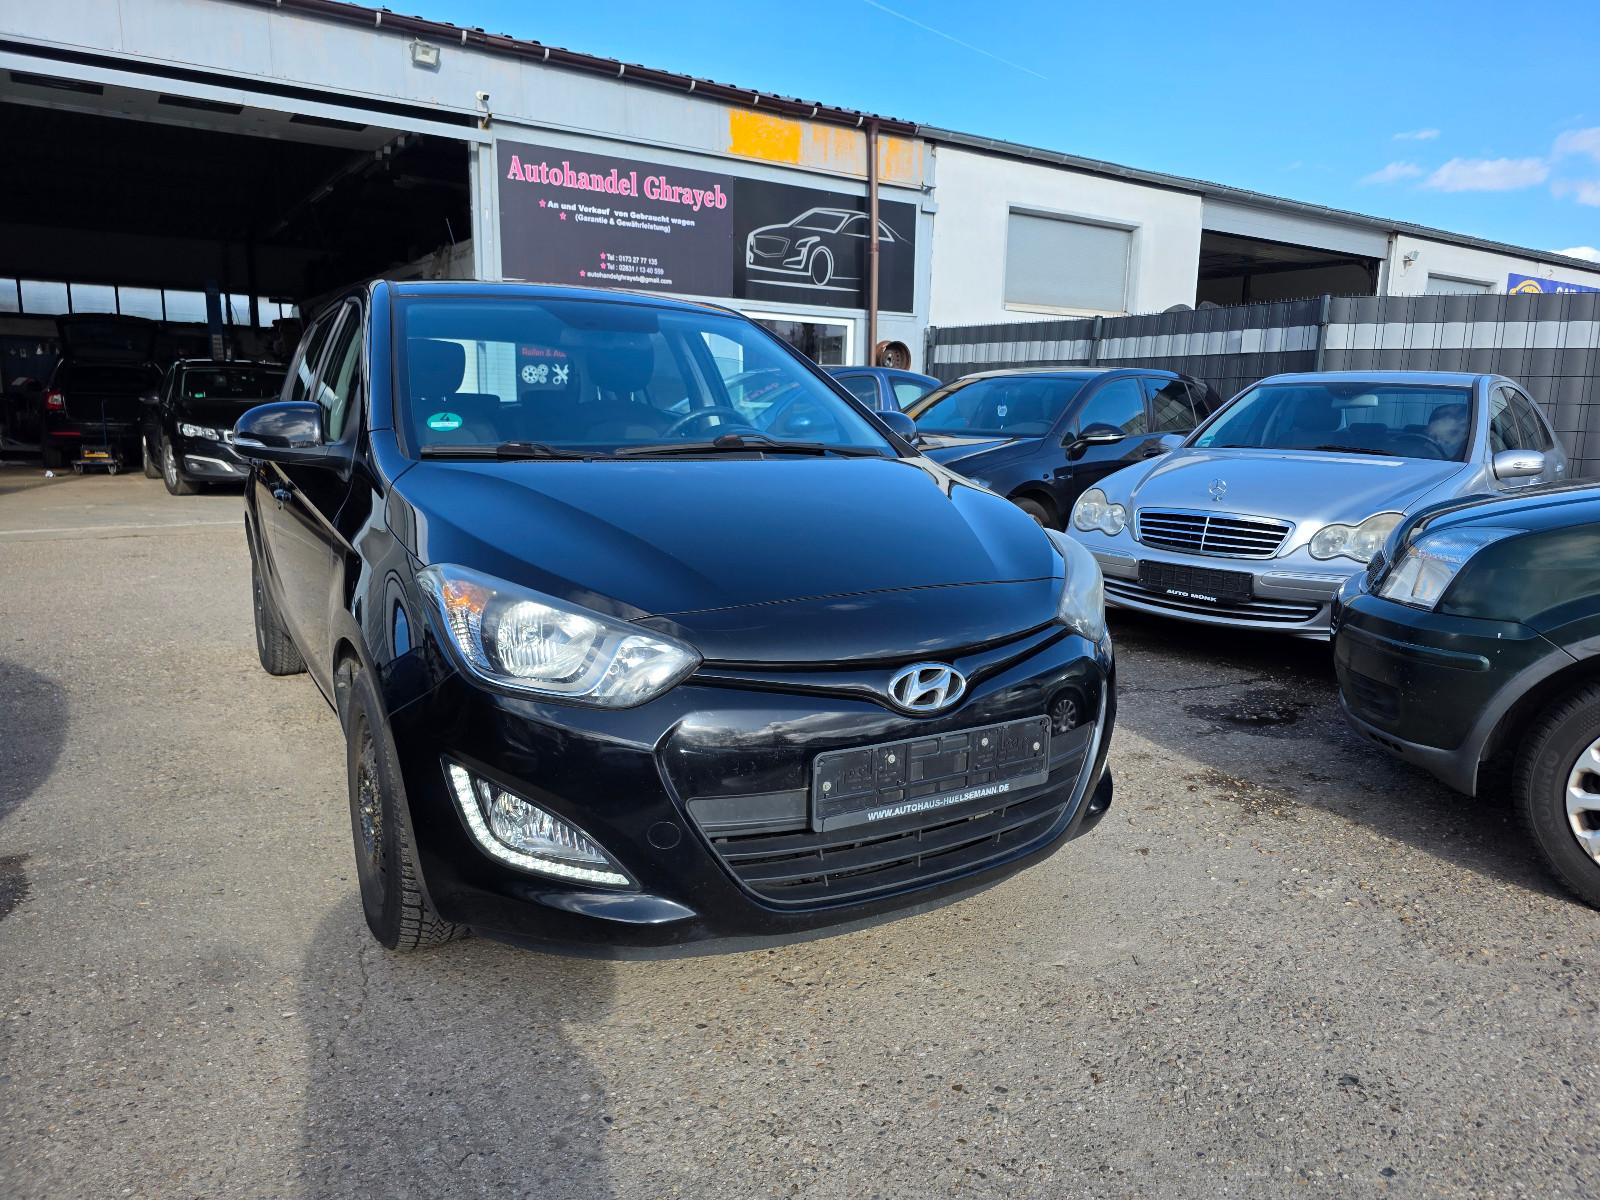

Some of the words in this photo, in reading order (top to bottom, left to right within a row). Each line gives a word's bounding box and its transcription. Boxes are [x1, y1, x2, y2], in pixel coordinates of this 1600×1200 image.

[507, 154, 638, 197] Autohandel
[643, 176, 727, 212] Ghrayeb
[547, 200, 559, 209] An
[561, 203, 577, 211] und
[578, 204, 610, 216] Verkauf
[614, 210, 629, 218] von
[630, 211, 670, 224] Gebraucht
[671, 217, 695, 227] wagen
[575, 213, 608, 225] (Garantie
[609, 217, 615, 226] &
[606, 253, 615, 261] Tel
[606, 262, 615, 270] Tel
[1166, 589, 1189, 598] AUTO
[867, 783, 1009, 822] WWW.AUTOHAUS-HUELSEMANN.DE
